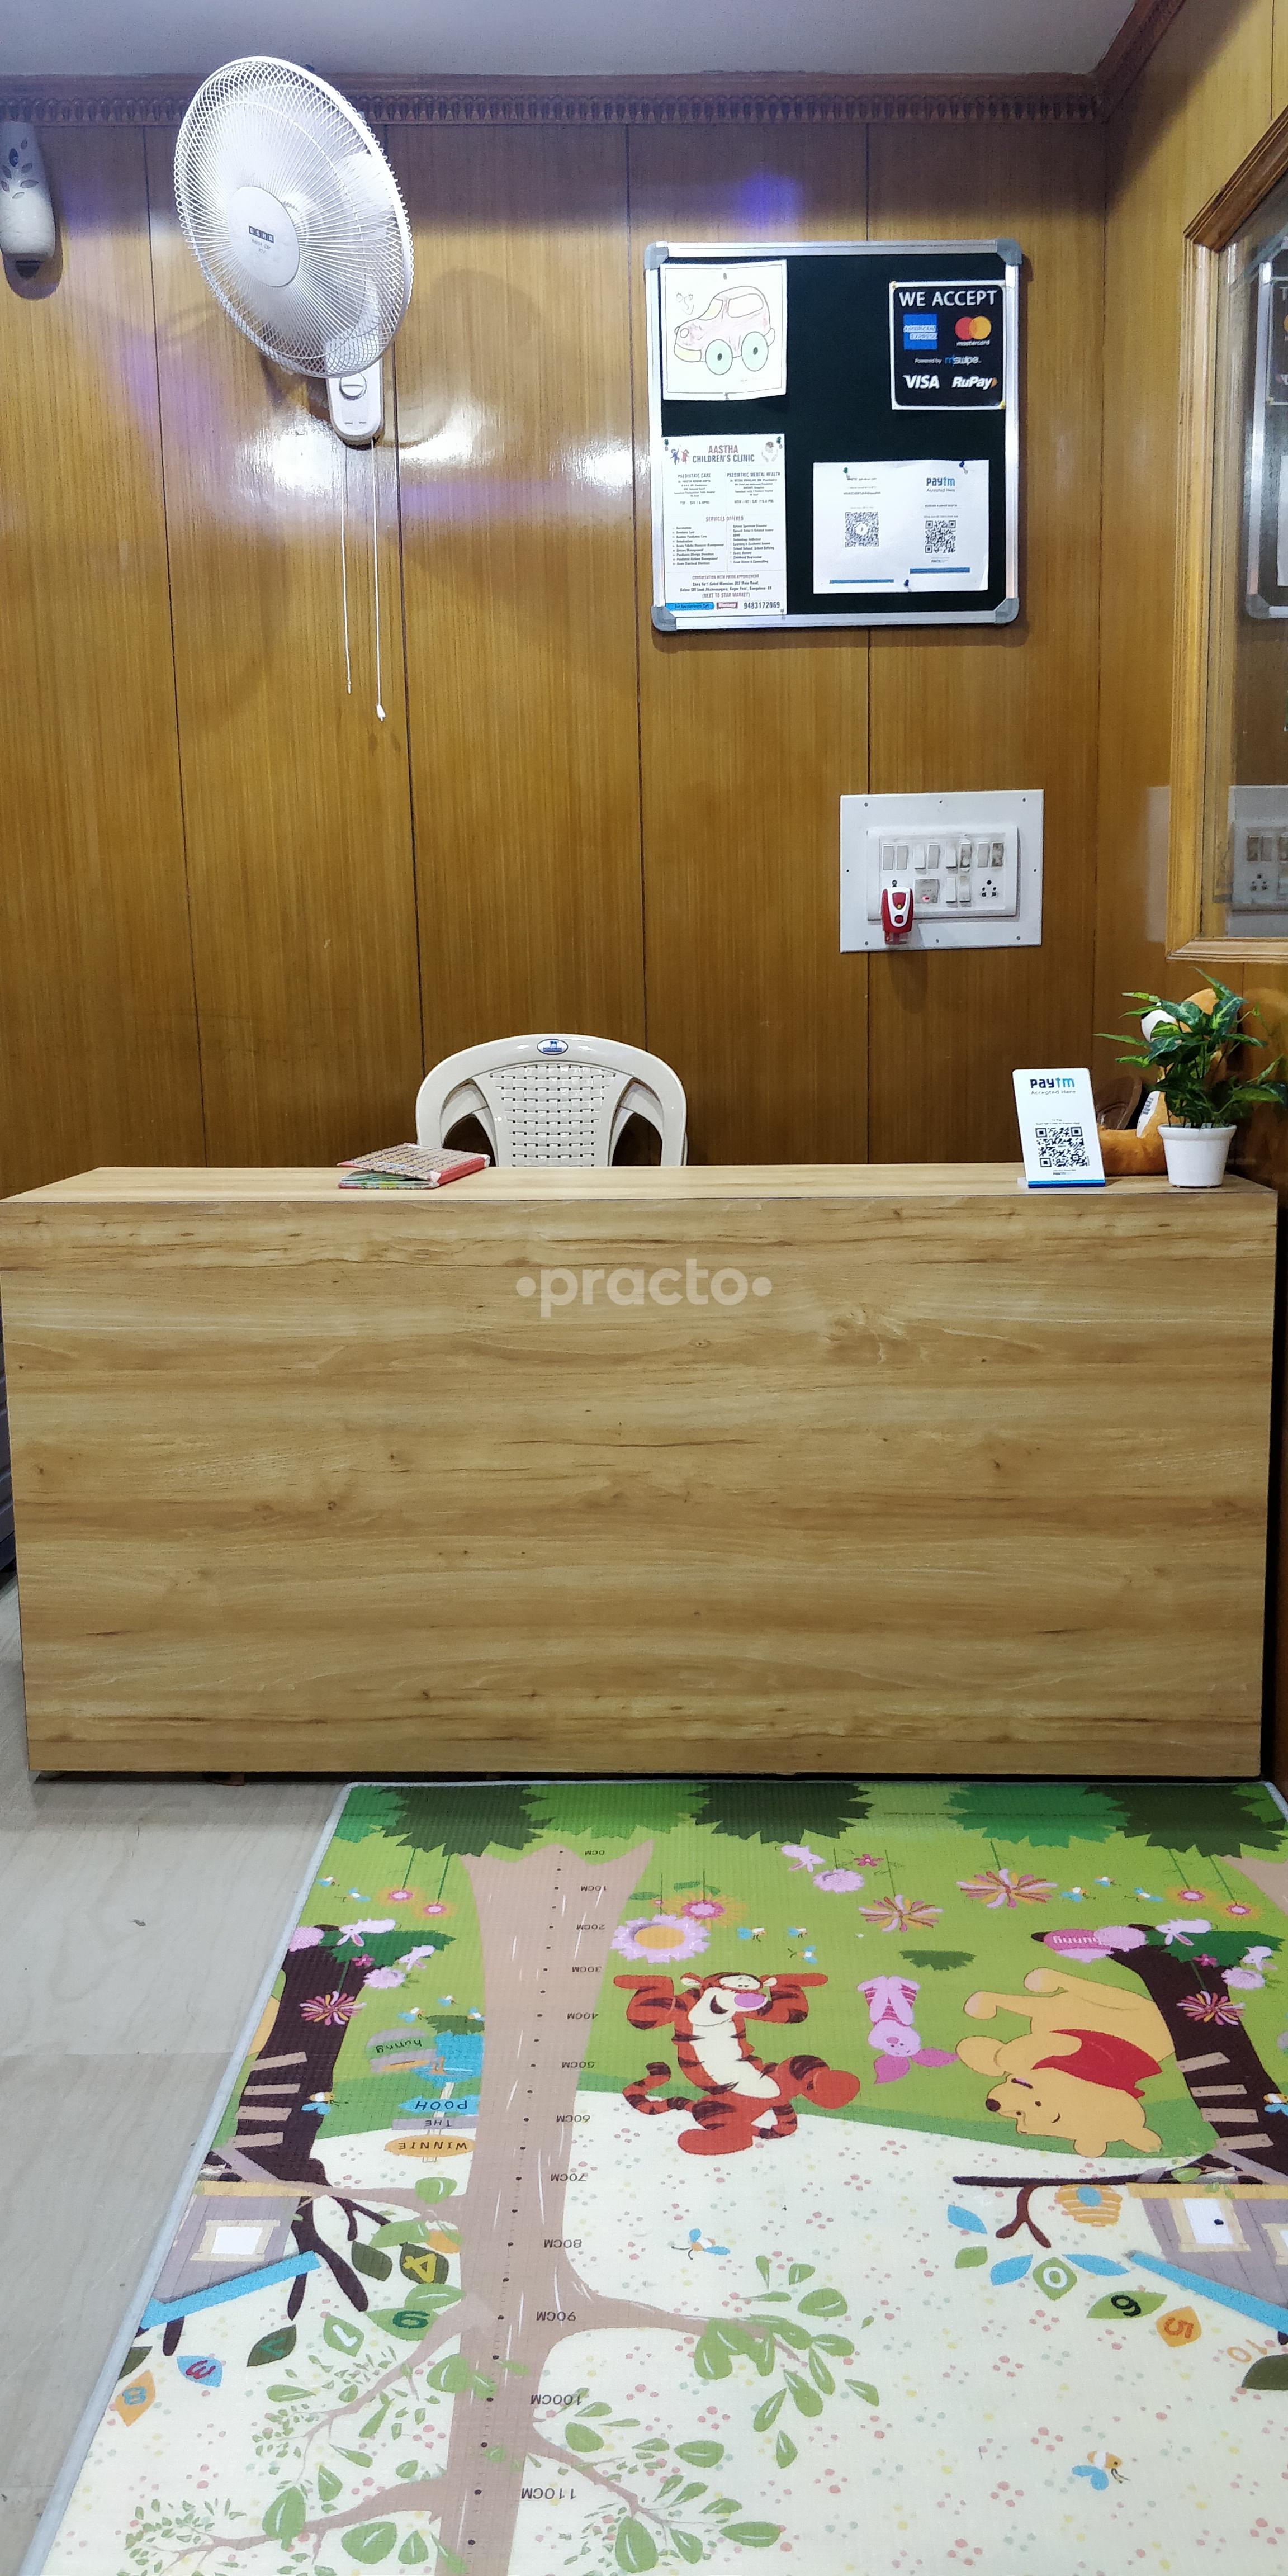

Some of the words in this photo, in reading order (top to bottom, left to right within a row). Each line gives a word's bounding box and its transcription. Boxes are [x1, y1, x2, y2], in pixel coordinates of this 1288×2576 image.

[899, 292, 926, 306] WE
[932, 290, 997, 306] ACCEPT
[903, 375, 940, 389] VISA
[951, 376, 993, 390] RuPay
[708, 445, 738, 454] AASTHA
[376, 2039, 423, 2053] hunny
[415, 2100, 468, 2110] POOH
[556, 2115, 591, 2123] 60CM
[398, 2142, 467, 2151] WINNIE
[551, 2173, 586, 2182] 70CM
[544, 2239, 583, 2248] 80CM
[402, 2253, 437, 2281] 4
[536, 2311, 577, 2322] 90CM
[1164, 2317, 1194, 2339] 5
[121, 2386, 146, 2405] 8
[531, 2395, 583, 2405] 100CM
[521, 2488, 576, 2499] 110CM
